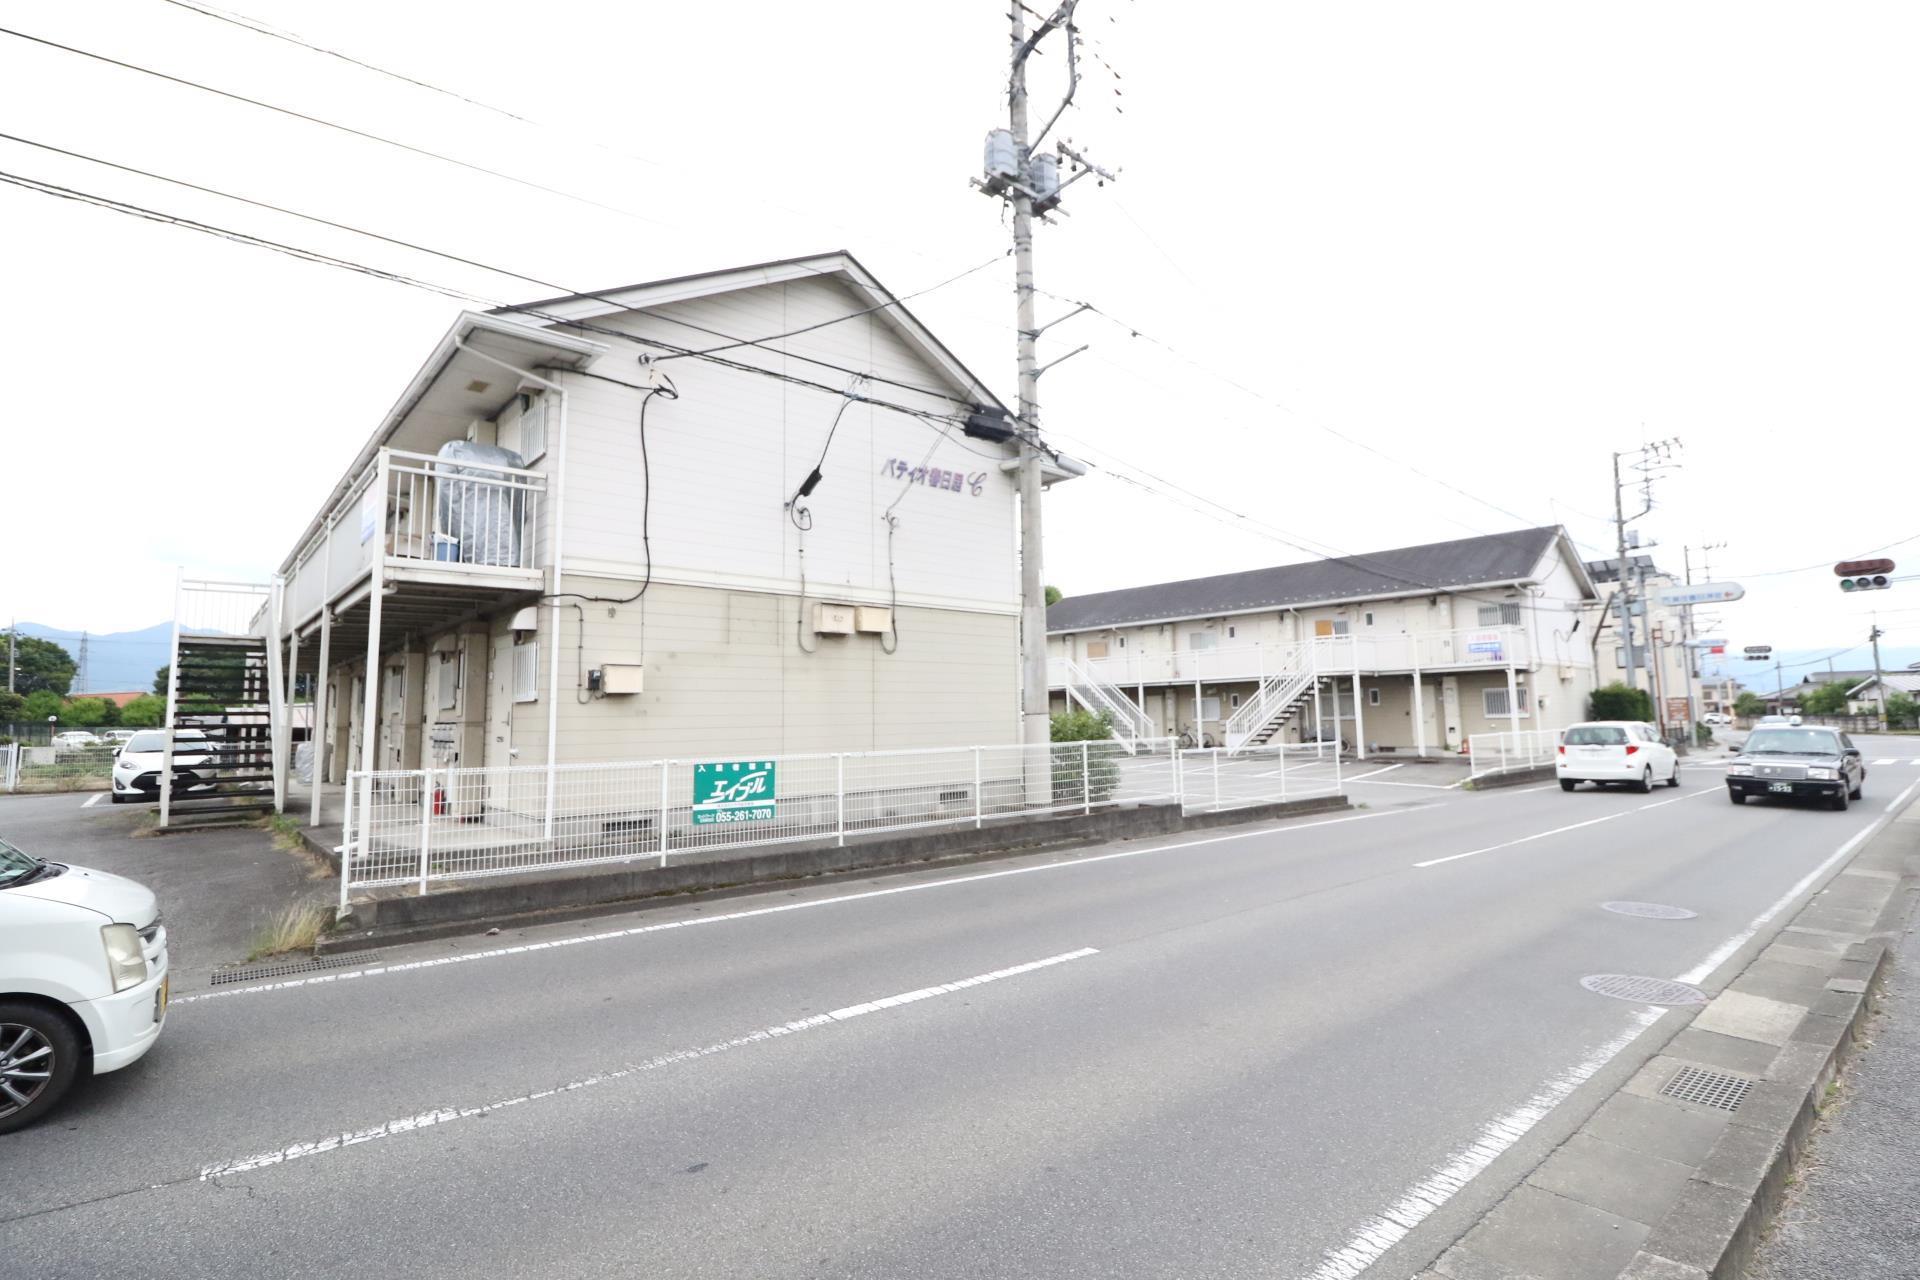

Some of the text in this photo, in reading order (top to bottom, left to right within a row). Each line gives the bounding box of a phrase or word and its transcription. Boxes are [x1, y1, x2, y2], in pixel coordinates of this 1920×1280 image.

[703, 771, 767, 803] エイブル
[716, 809, 771, 822] 055-261-7070
